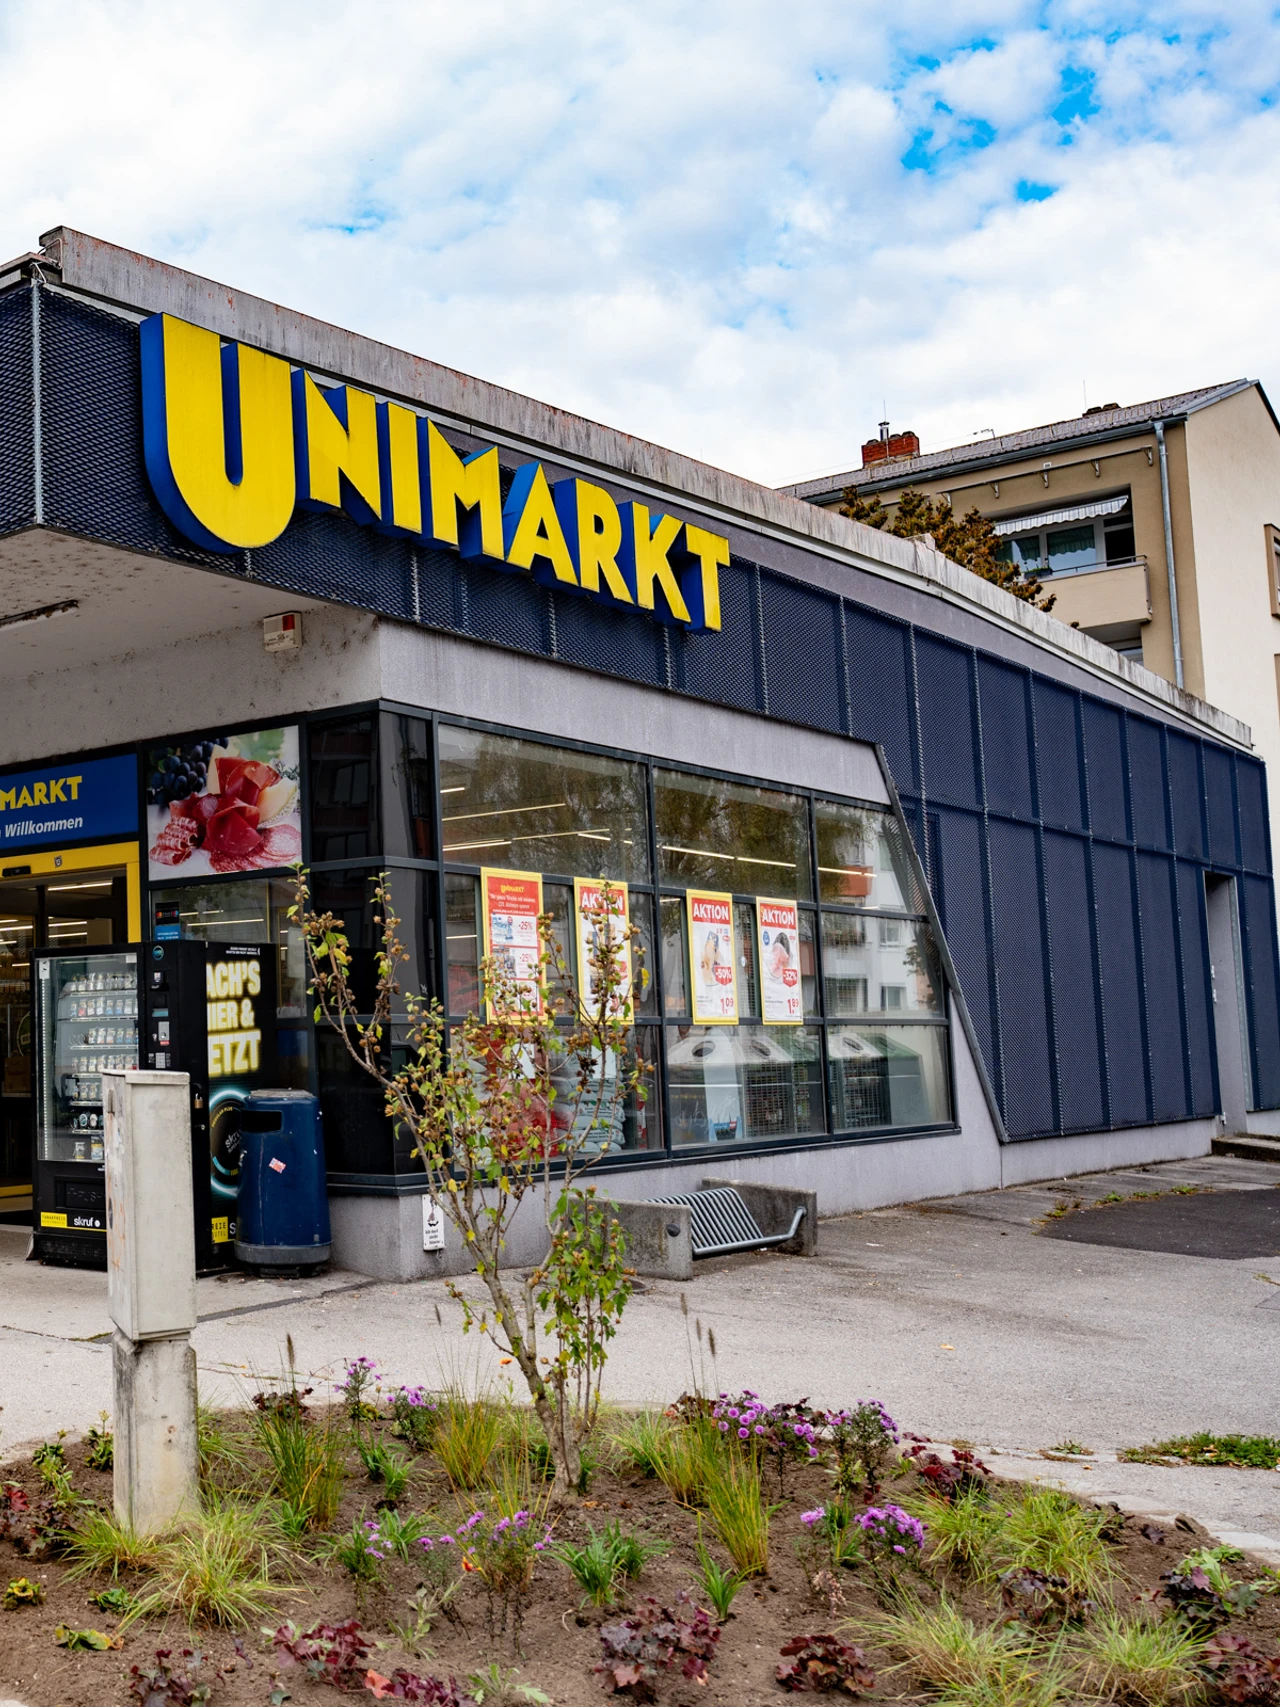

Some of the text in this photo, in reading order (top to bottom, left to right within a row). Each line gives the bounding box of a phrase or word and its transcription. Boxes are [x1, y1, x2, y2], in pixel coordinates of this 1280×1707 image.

[140, 312, 730, 635] UNIMARKT
[5, 817, 83, 838] Willkommen
[581, 892, 624, 911] AKIN
[693, 903, 729, 920] AKTION
[762, 909, 795, 925] AKTION
[715, 966, 732, 979] -50%
[783, 970, 798, 981] -32%
[240, 997, 255, 1028] &
[207, 1029, 261, 1077] ETZT
[73, 1216, 94, 1227] skruf
